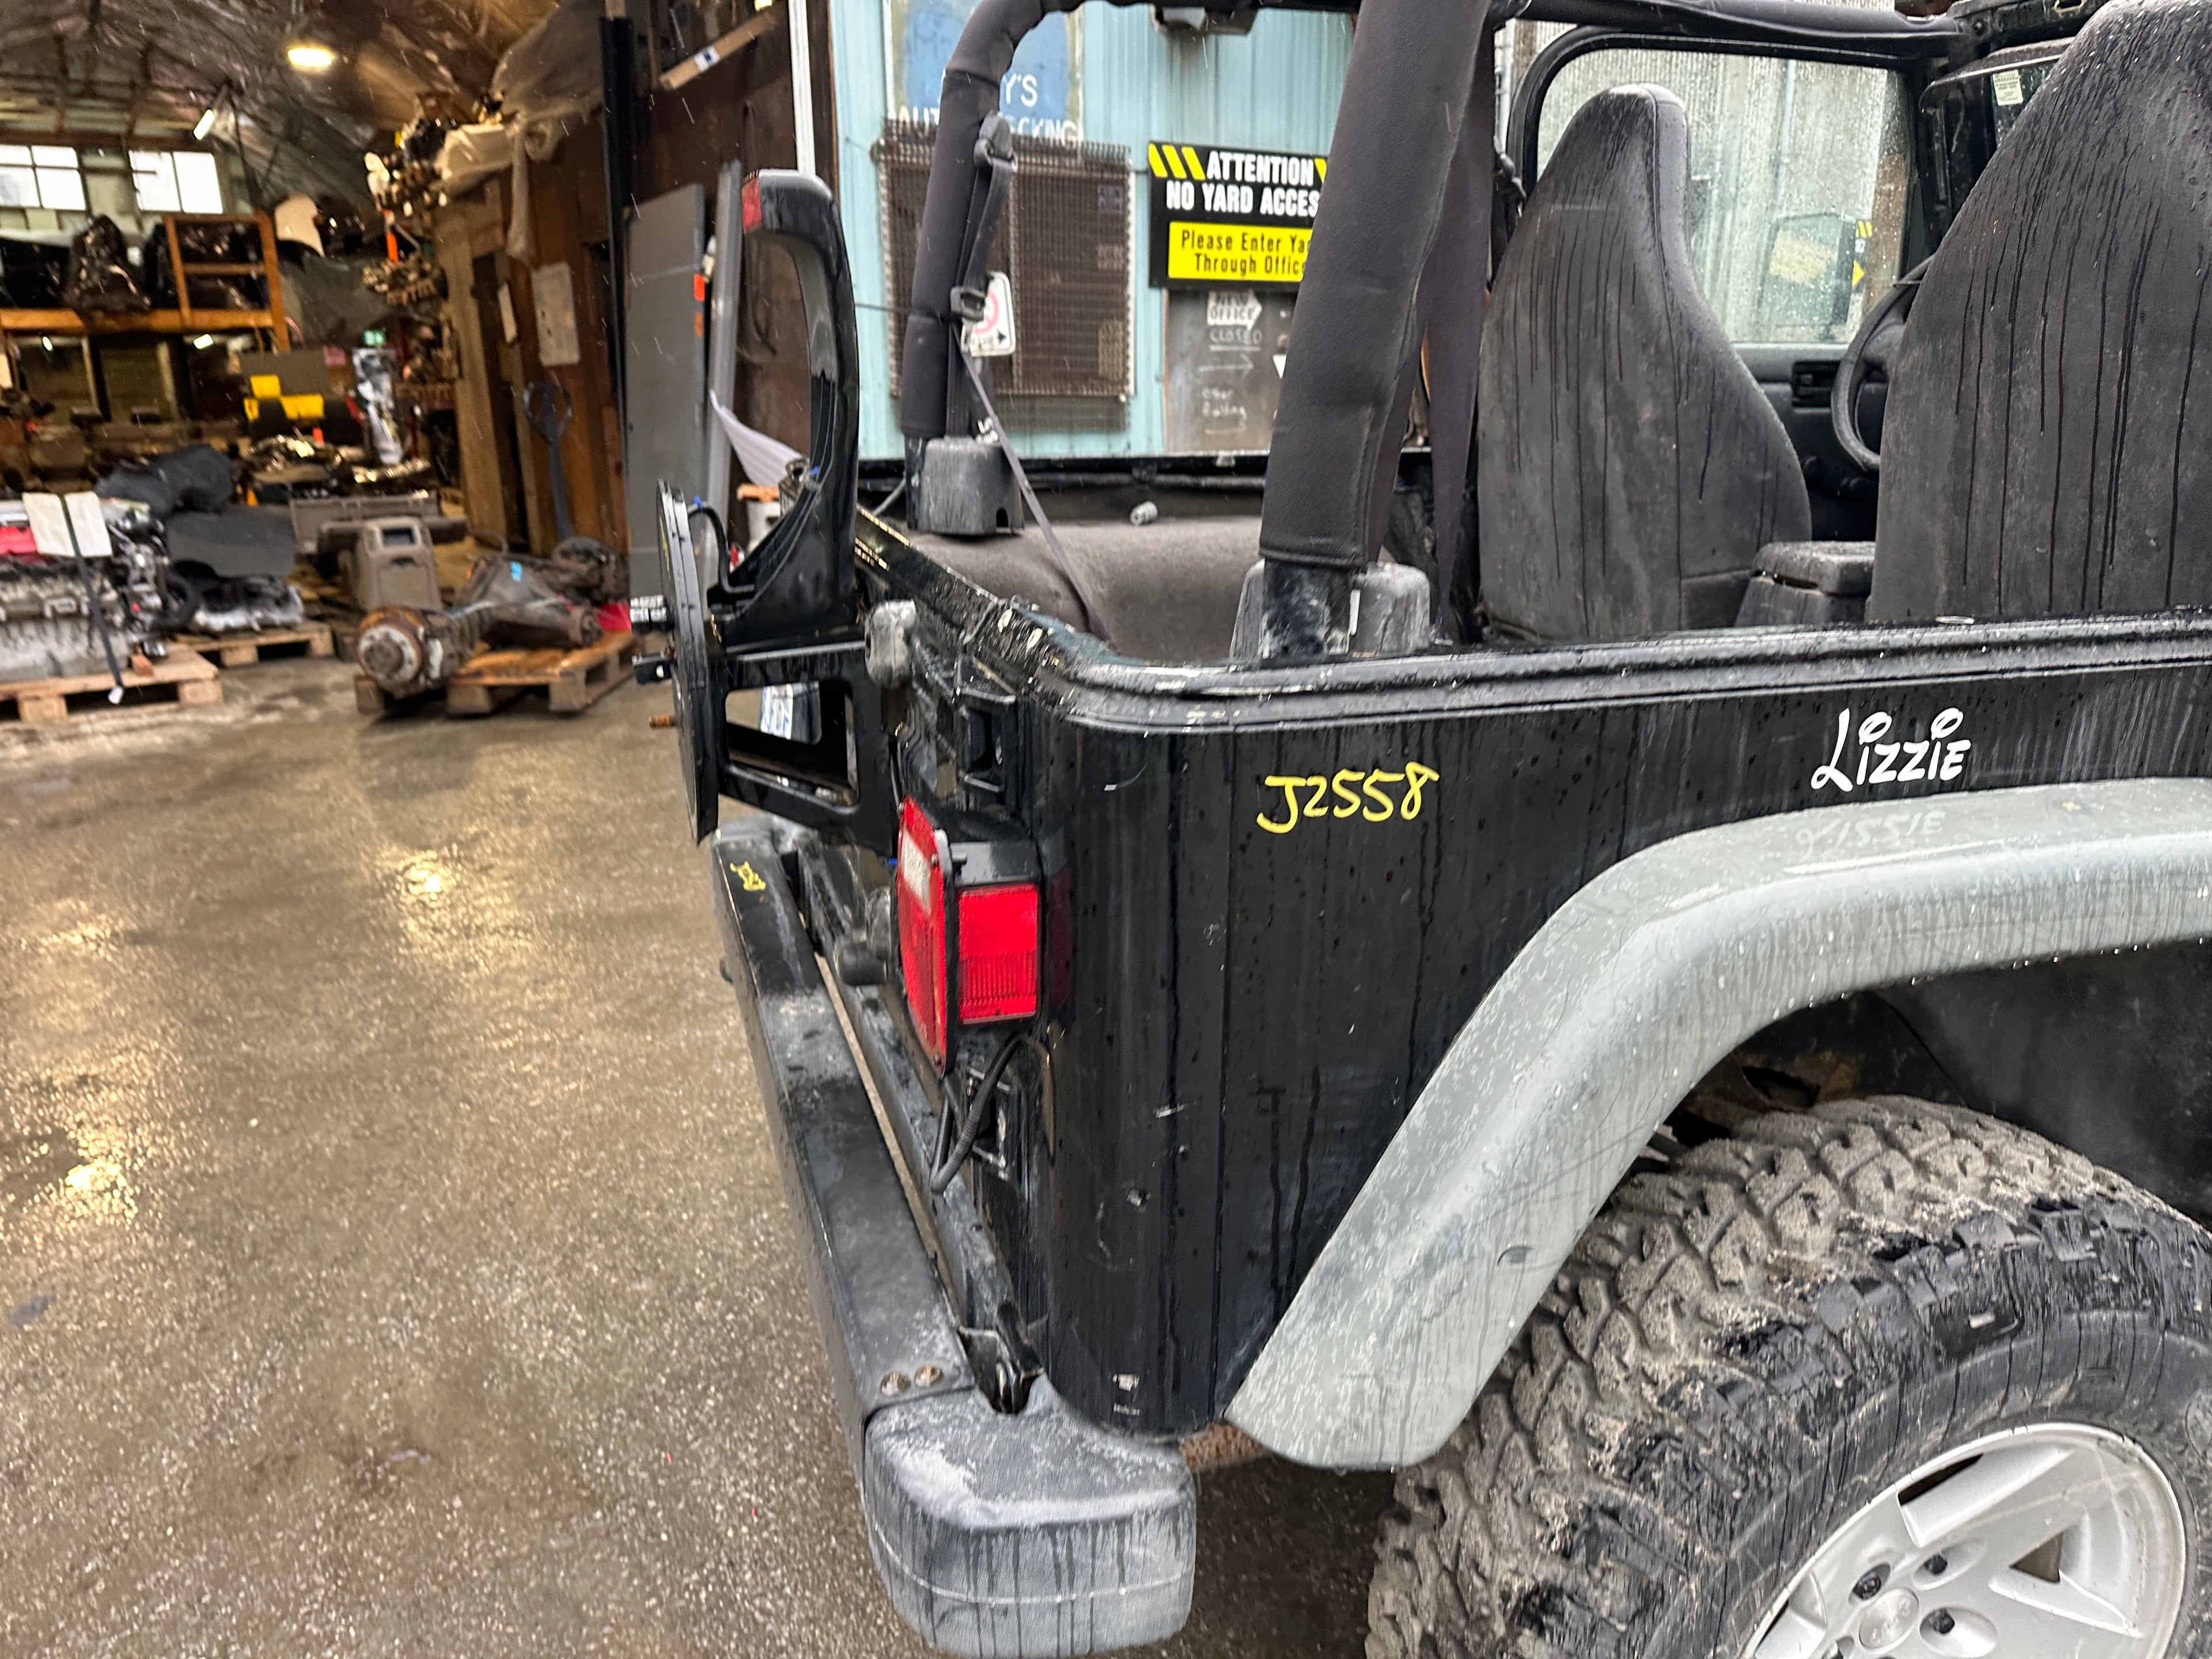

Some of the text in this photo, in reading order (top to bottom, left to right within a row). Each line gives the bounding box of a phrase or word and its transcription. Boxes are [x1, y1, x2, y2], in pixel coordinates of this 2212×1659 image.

[1206, 151, 1314, 186] ATTENTION
[1166, 179, 1320, 218] NO YARD ACCES
[1181, 229, 1233, 250] Please
[1241, 232, 1282, 252] Enter
[1195, 252, 1256, 276] Through
[1256, 761, 1440, 834] J2558
